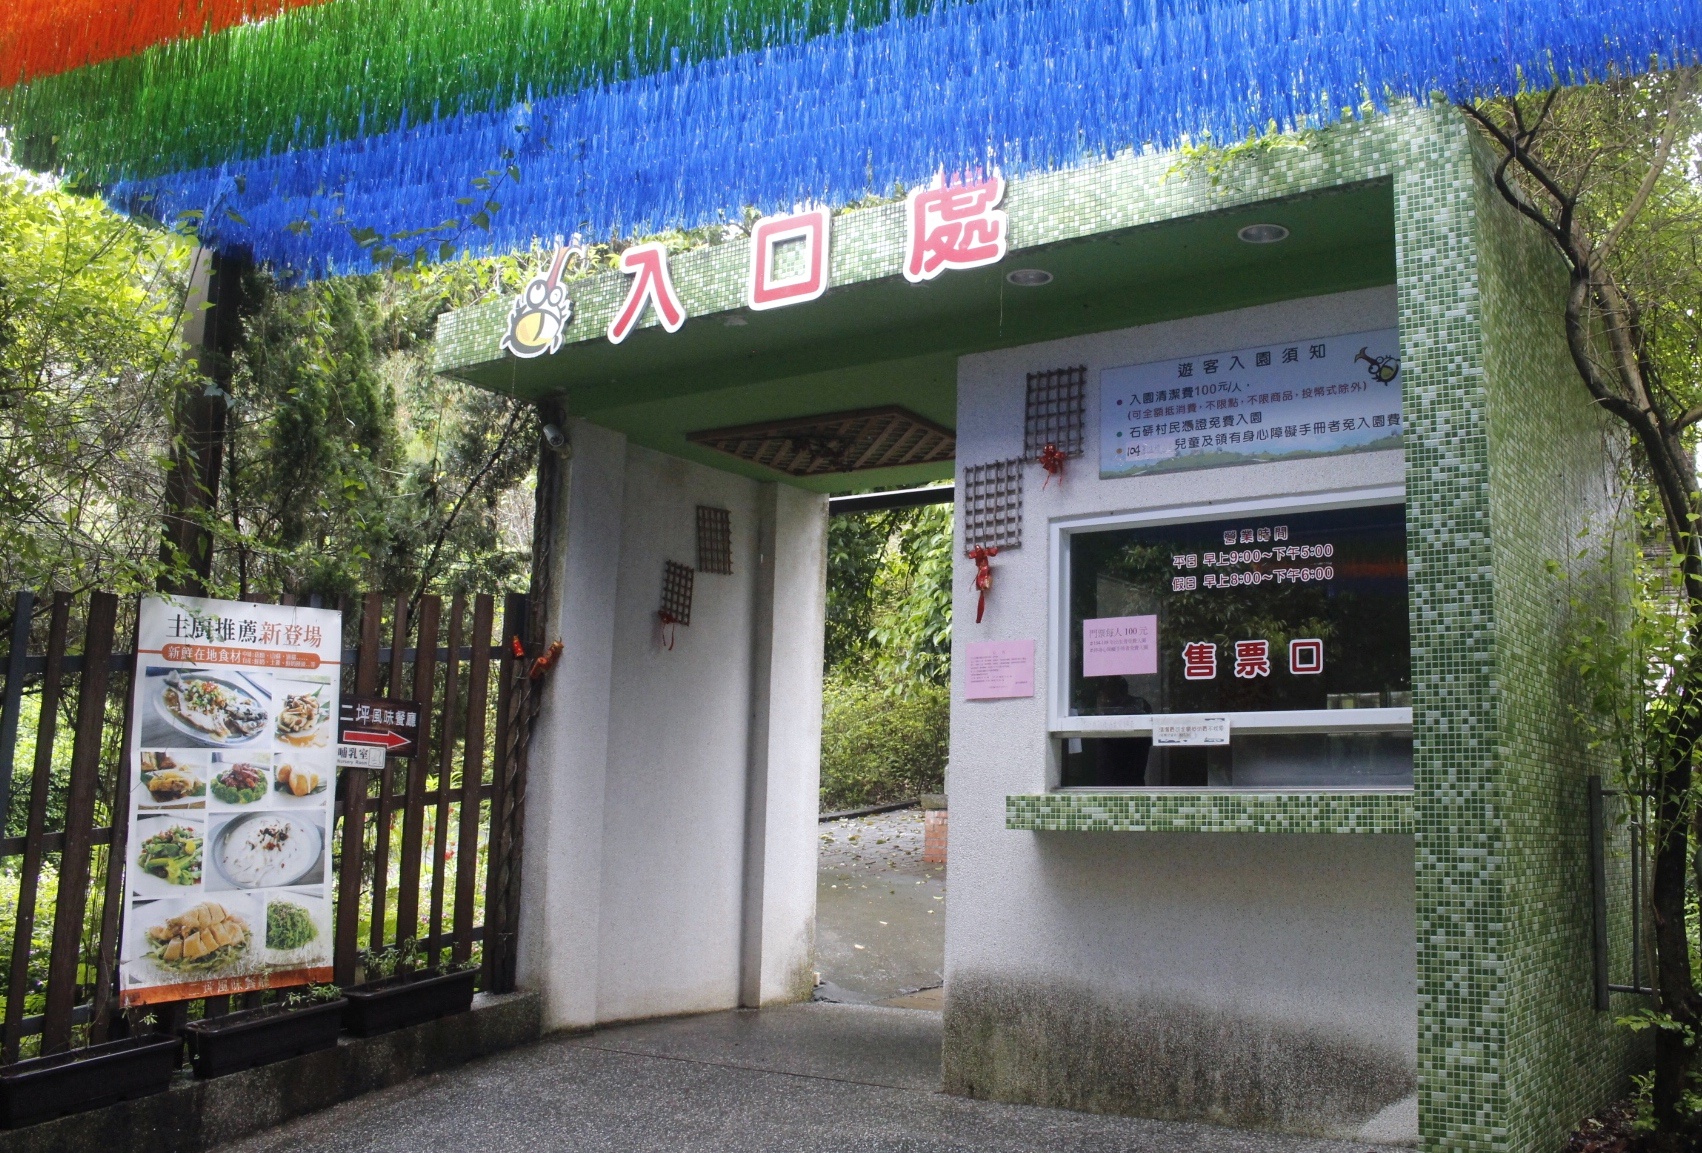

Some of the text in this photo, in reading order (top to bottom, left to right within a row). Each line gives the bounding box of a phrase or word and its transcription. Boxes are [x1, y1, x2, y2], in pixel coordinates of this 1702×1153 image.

[608, 168, 1008, 345] 入口處
[1178, 344, 1326, 378] 遊客入園須知
[1223, 525, 1289, 546] 營業時間
[1172, 553, 1198, 570] 平日
[1171, 576, 1197, 592] 假日
[1124, 627, 1138, 636] 100
[168, 645, 242, 664] 新鮮在地食材
[1182, 637, 1324, 681] 售票口
[340, 703, 417, 727] 二坪風味餐廳
